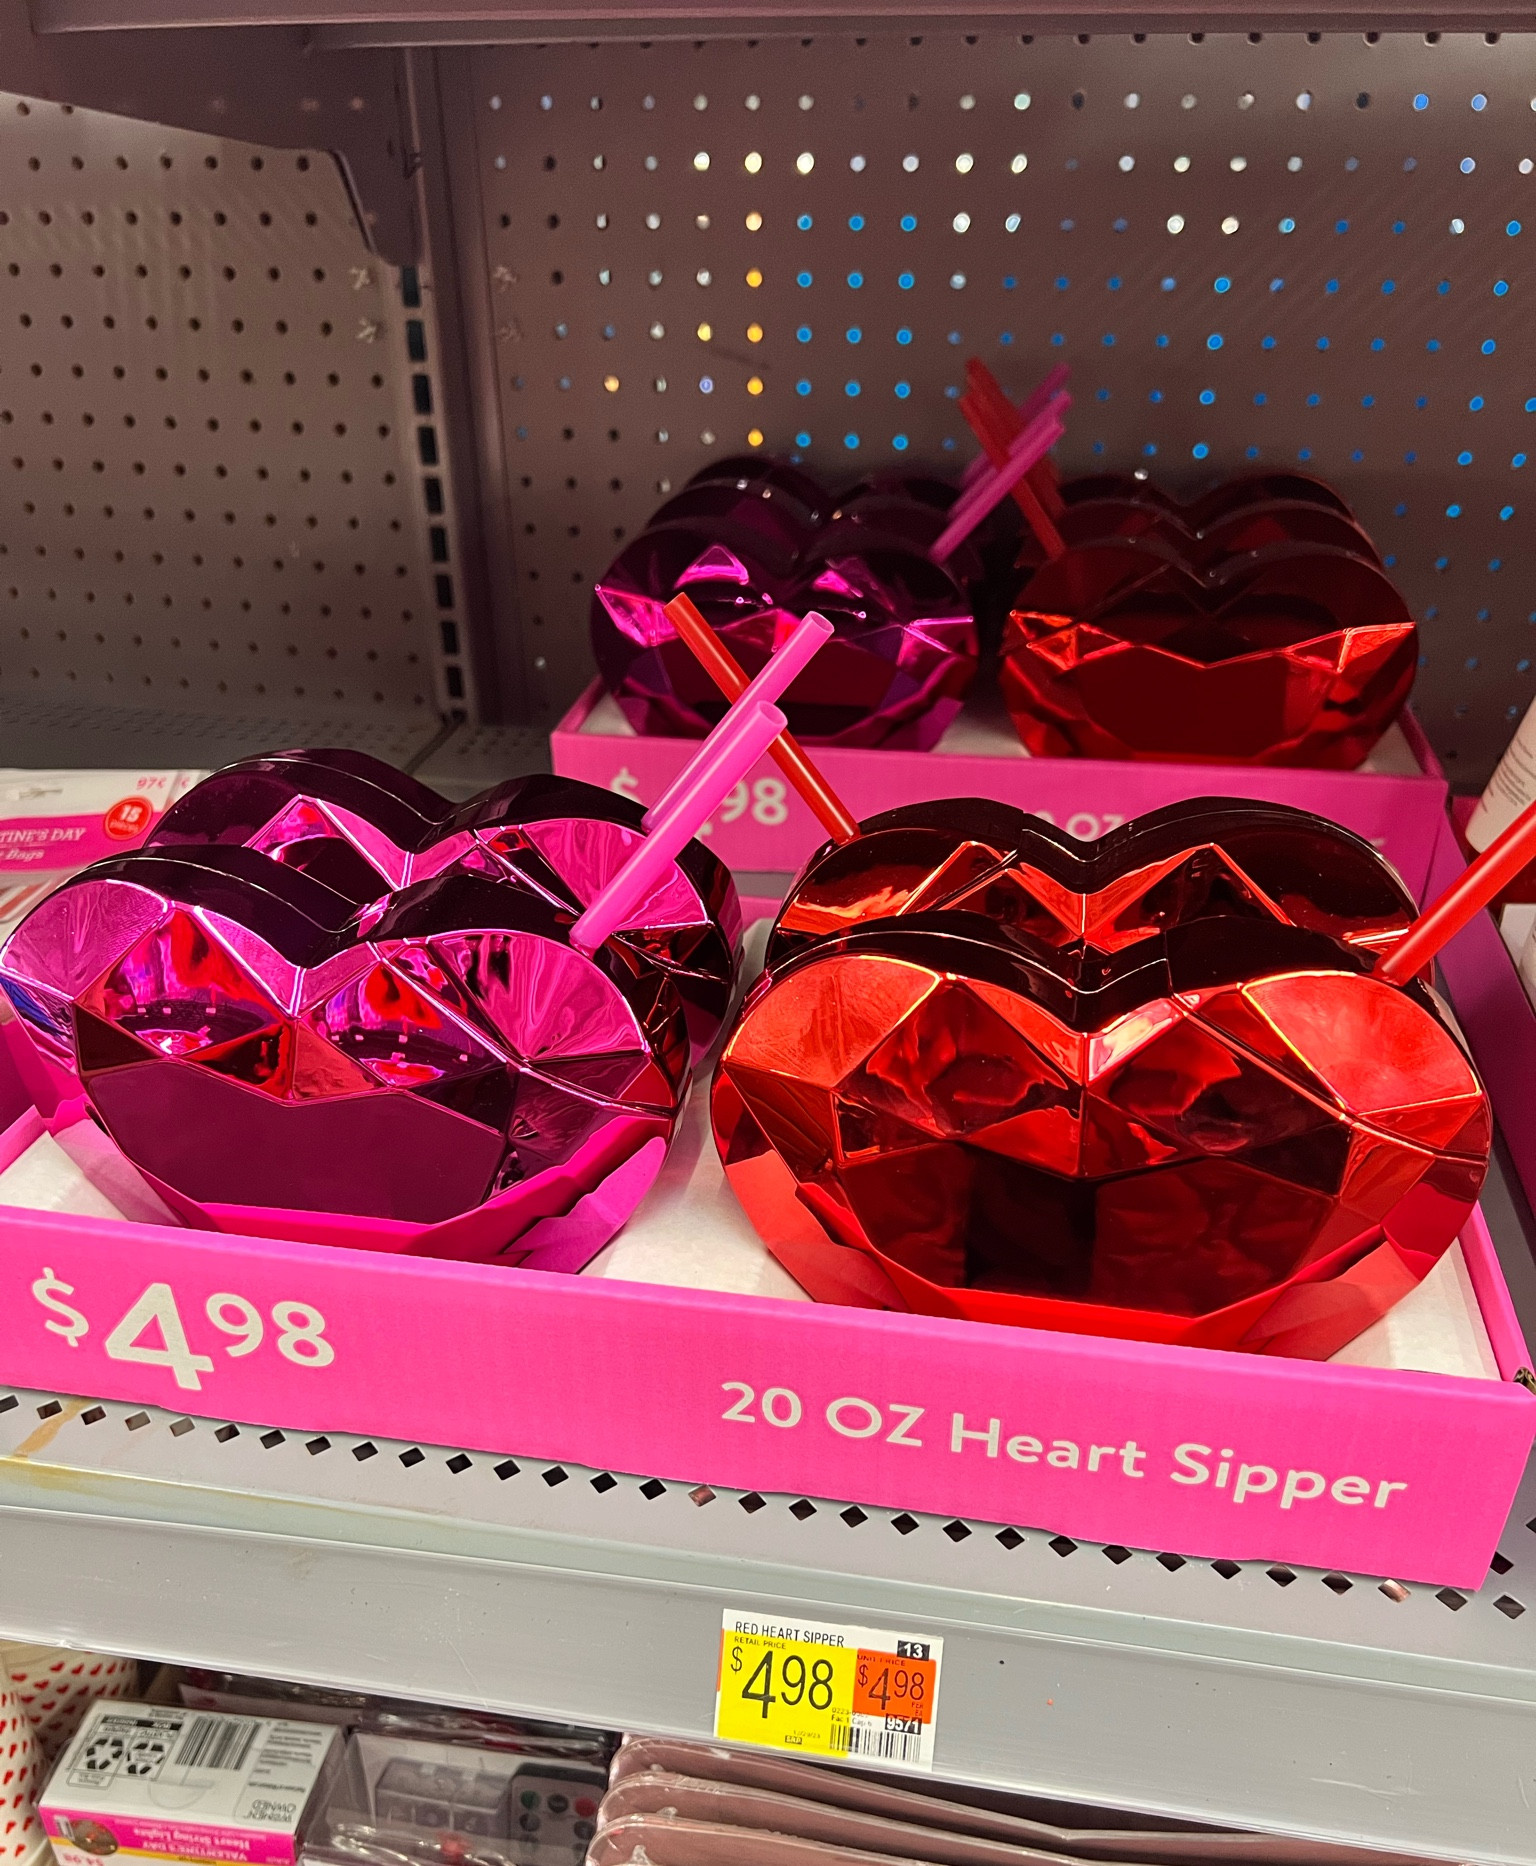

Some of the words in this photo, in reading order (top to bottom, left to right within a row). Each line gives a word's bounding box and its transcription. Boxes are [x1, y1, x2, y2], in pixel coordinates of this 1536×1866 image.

[50, 826, 87, 842] DAY
[5, 848, 45, 862] Bags
[720, 1381, 803, 1427] 20
[825, 1396, 924, 1447] OZ
[950, 1412, 1147, 1479] Heart
[1170, 1442, 1409, 1510] Sipper
[734, 1636, 761, 1646] RETAIL
[763, 1640, 787, 1649] PRICE
[735, 1621, 759, 1635] RED
[761, 1624, 800, 1642] HEART
[803, 1630, 845, 1648] SIPPER
[903, 1643, 924, 1659] 13
[886, 1714, 920, 1734] 9571
[142, 1840, 169, 1852] DAY
[213, 1836, 250, 1850] Heart
